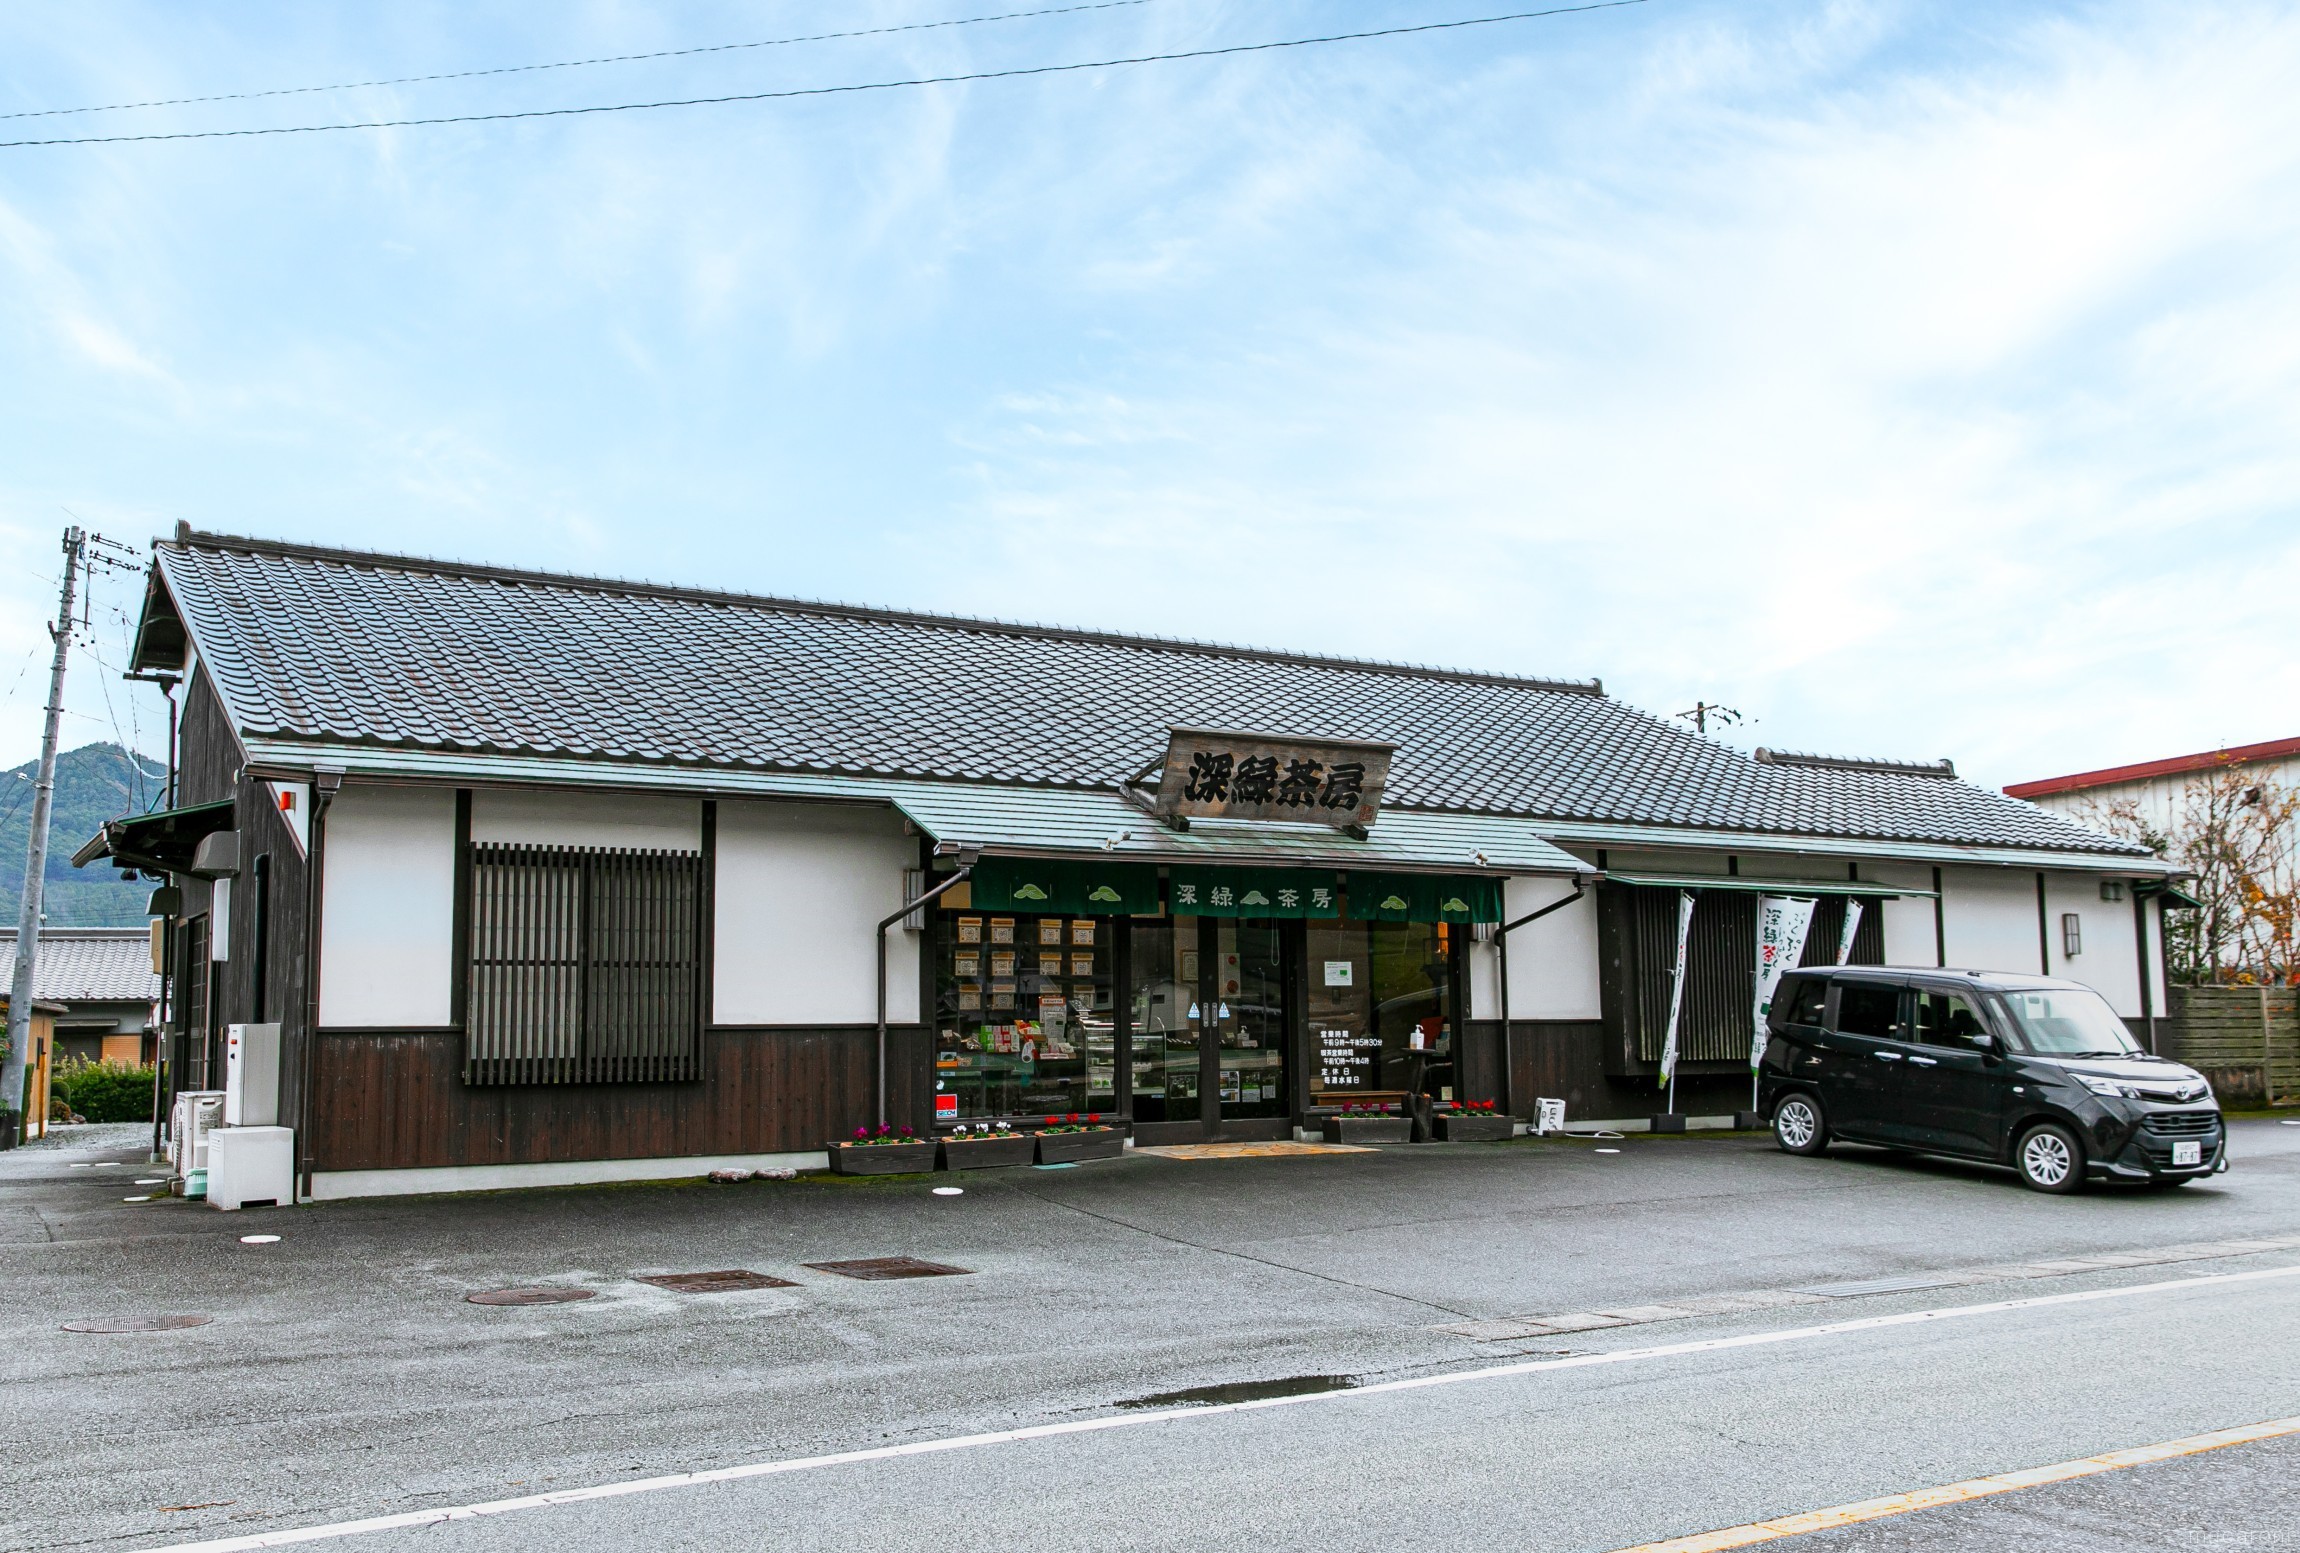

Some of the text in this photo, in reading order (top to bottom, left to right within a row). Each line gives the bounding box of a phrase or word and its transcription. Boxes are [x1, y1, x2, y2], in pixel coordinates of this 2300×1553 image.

[1184, 752, 1366, 811] 深緑茶房
[1761, 907, 1782, 981] 深緑茶房
[1320, 1030, 1349, 1038] 営業時間
[1324, 1076, 1360, 1084] 毎週水曜日
